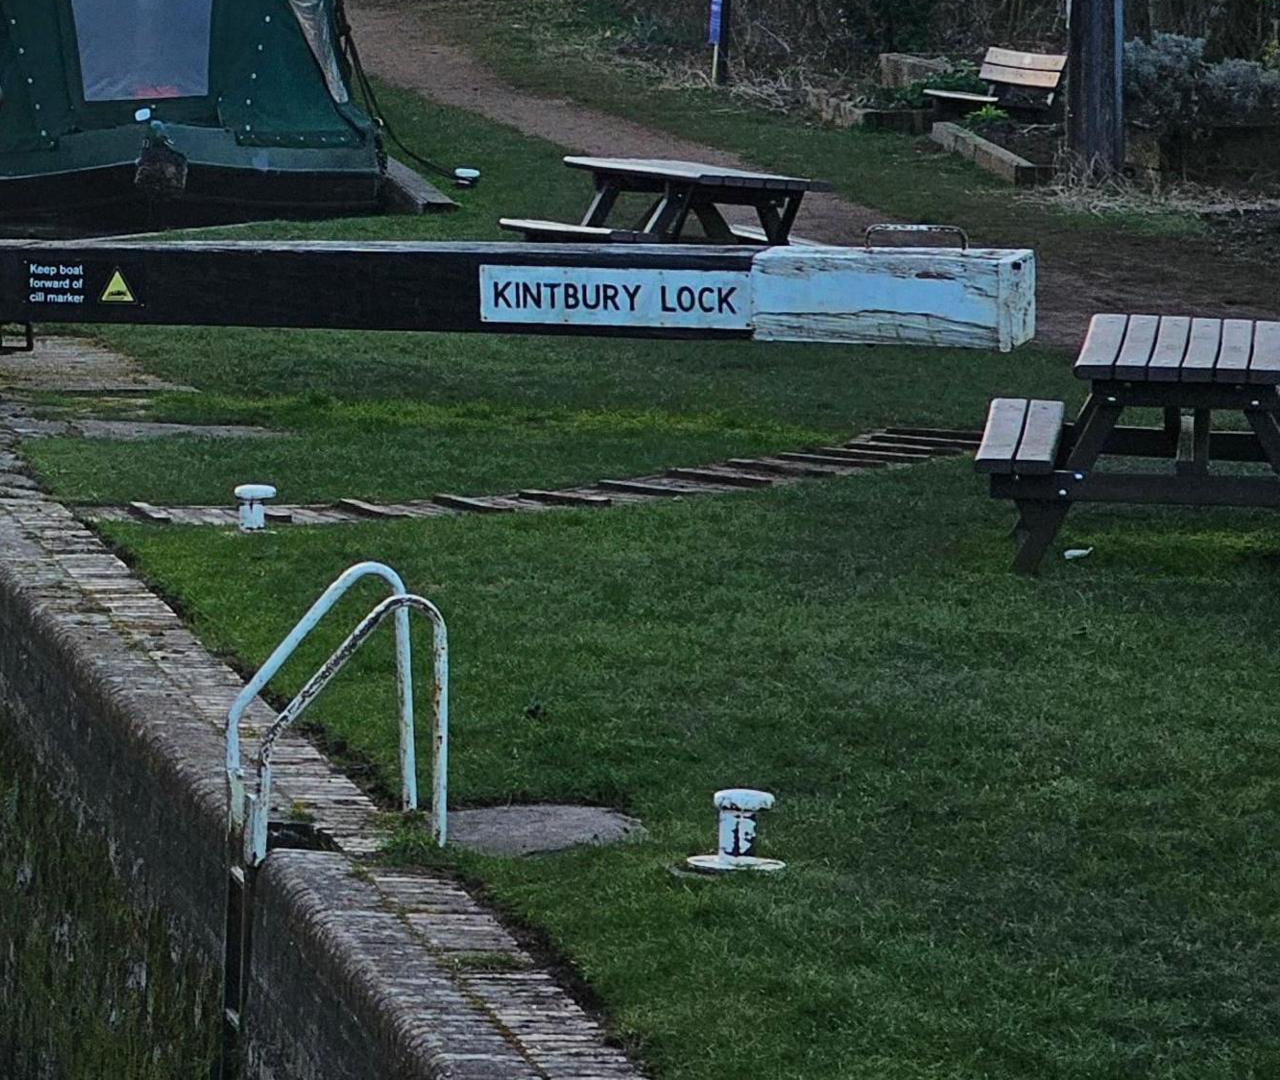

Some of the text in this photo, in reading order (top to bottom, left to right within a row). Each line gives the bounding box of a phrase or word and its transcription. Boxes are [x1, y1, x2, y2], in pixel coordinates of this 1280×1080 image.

[29, 263, 84, 276] Keep boat
[29, 277, 83, 289] forward of
[29, 291, 85, 303] cill marker
[493, 280, 738, 314] KINTBURY LOCK
